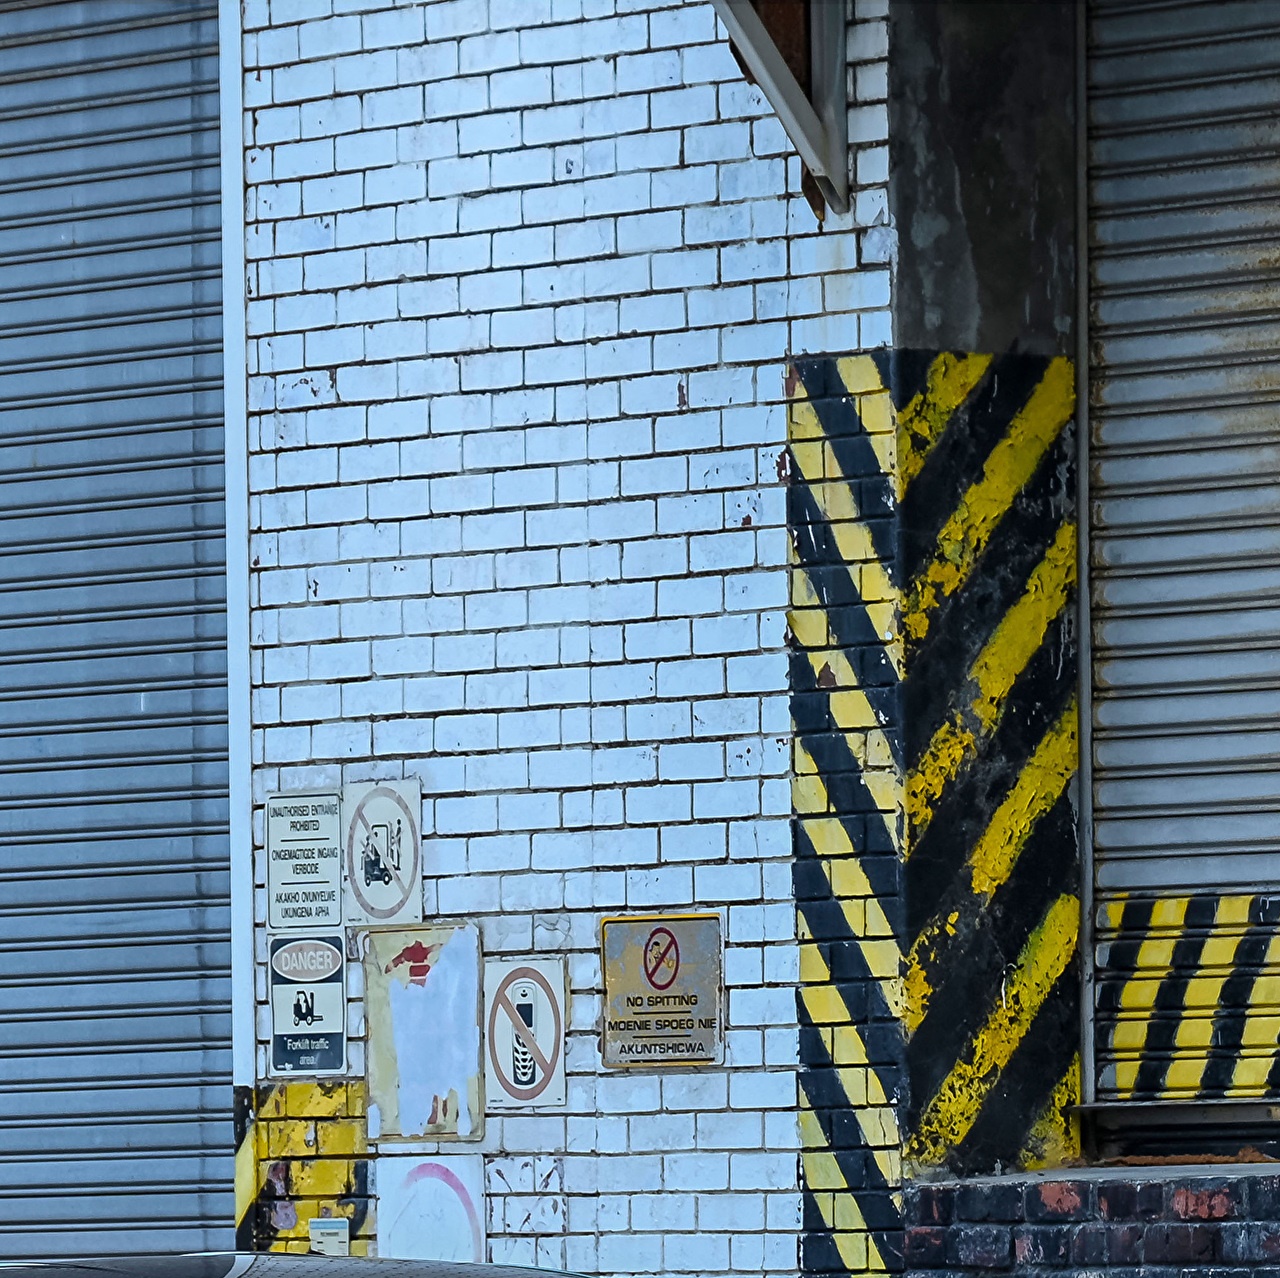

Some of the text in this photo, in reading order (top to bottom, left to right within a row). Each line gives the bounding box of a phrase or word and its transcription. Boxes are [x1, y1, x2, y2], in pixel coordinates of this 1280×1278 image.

[270, 803, 338, 818] UNAUTHORISED ENTRANCE
[290, 820, 320, 832] PROHIBITED
[272, 847, 338, 861] ONGEMAGTIGDE INGANG
[292, 863, 320, 875] VERBODE
[275, 891, 300, 903] AKAKHO
[281, 906, 330, 919] UKUNGENA APHA
[281, 950, 333, 972] DANGER
[626, 994, 698, 1007] NO SPITTING
[608, 1018, 717, 1031] MOENIE SPOEG NIE
[286, 1037, 329, 1050] Forklift traffic
[619, 1042, 705, 1055] AKUNTSHICWA
